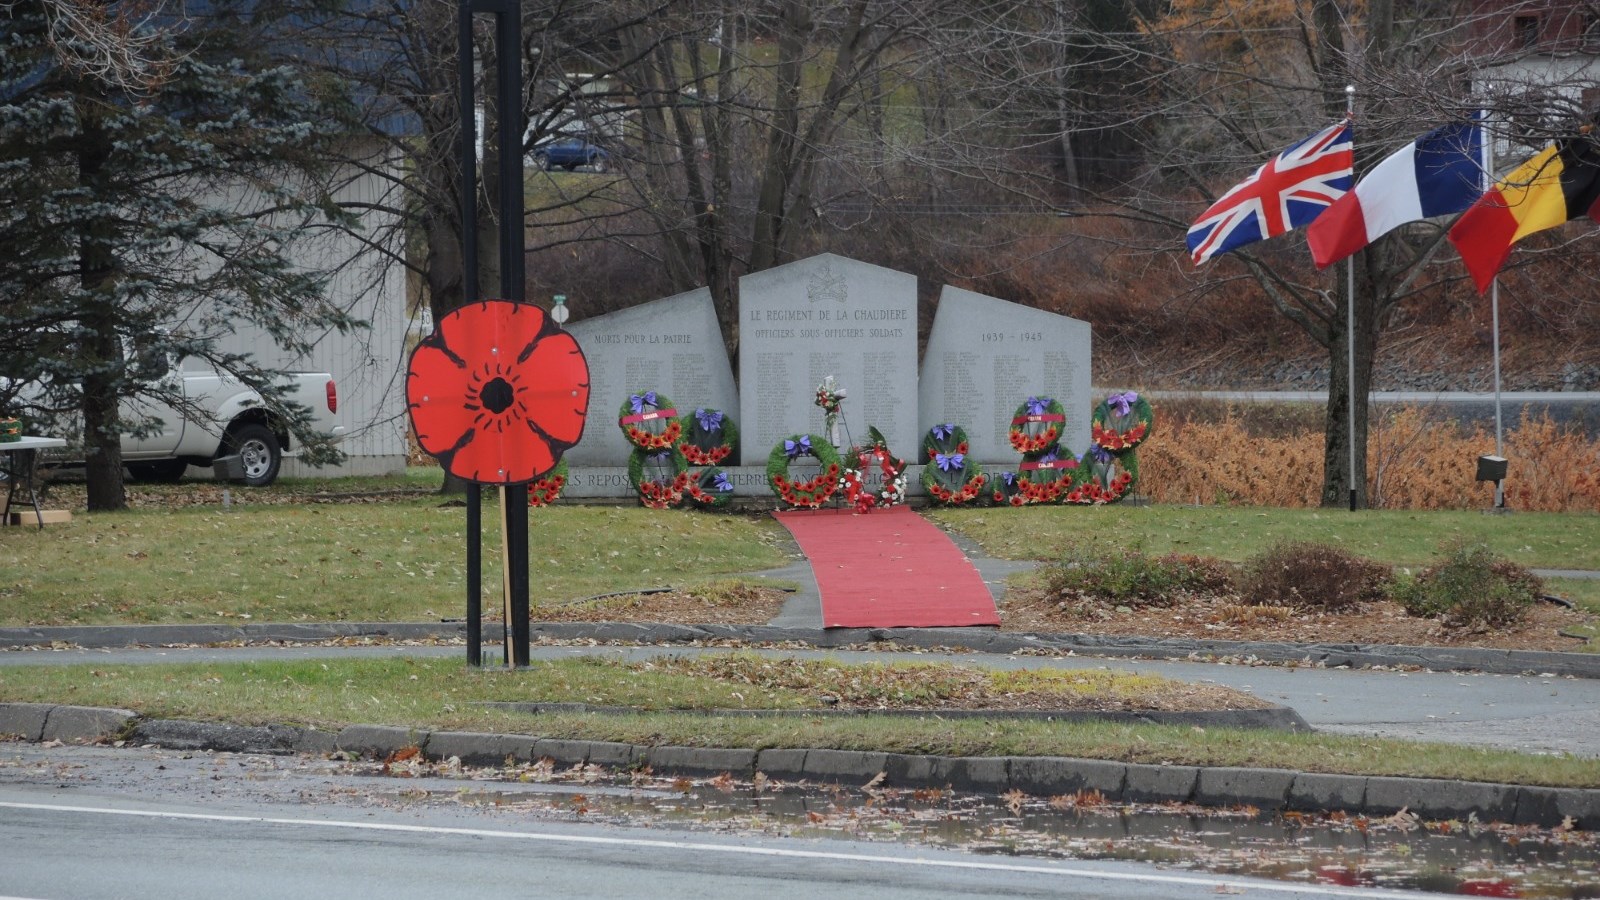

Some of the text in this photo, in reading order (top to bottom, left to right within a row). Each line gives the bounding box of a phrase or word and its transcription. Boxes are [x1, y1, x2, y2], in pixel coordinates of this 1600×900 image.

[750, 309, 907, 321] LE REGIMENT DE LA CHAUDIERE
[755, 329, 795, 338] OFFICIERS
[869, 328, 903, 338] SOLDATS
[981, 332, 1004, 342] 1939
[1020, 332, 1042, 341] 1945
[594, 334, 692, 344] MORTS POUR LA PATRIE
[588, 474, 631, 487] REPOS
[732, 473, 769, 487] TERRE
